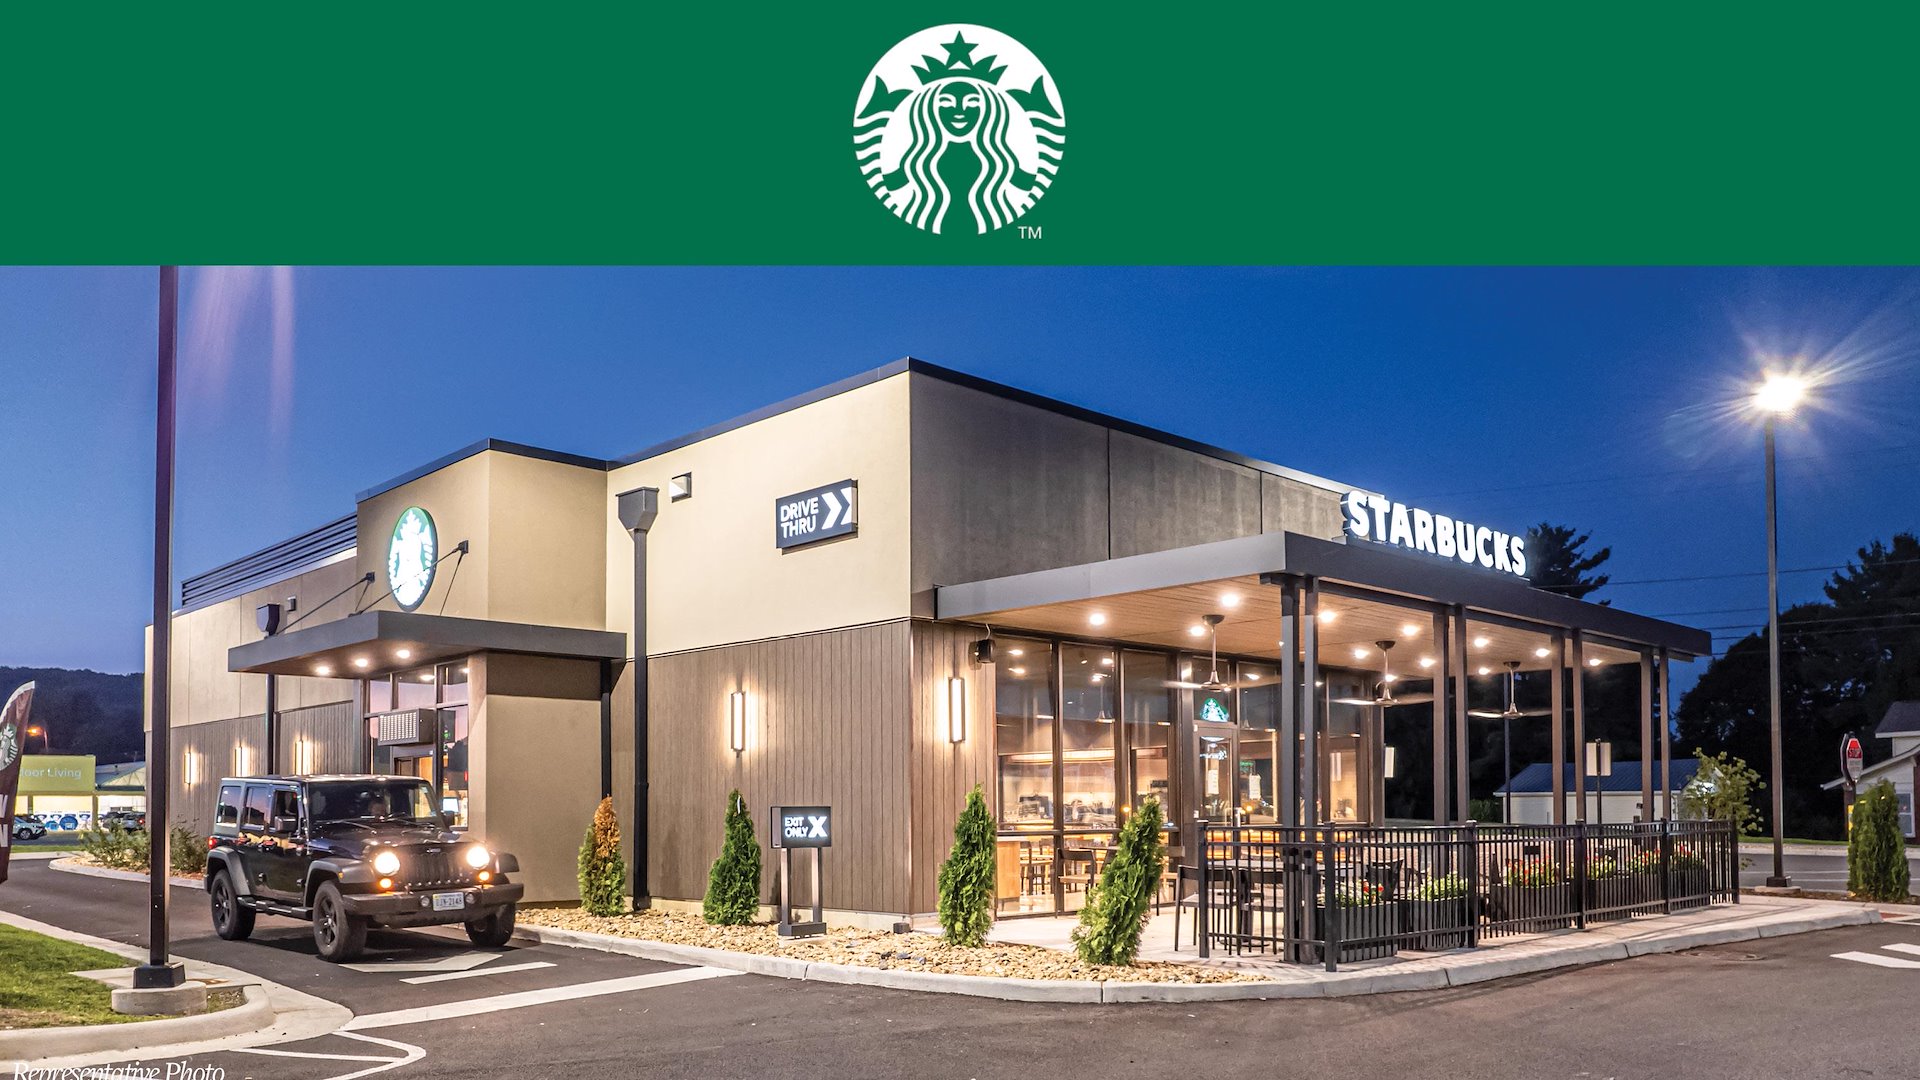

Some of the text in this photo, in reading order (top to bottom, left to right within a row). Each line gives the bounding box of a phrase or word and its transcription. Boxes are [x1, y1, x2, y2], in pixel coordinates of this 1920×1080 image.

[780, 497, 819, 522] DRIVE
[780, 515, 817, 539] THRU
[1345, 490, 1527, 576] STARBUCKS
[47, 767, 82, 779] Living
[784, 817, 804, 827] EXIT
[784, 827, 808, 838] ONLY
